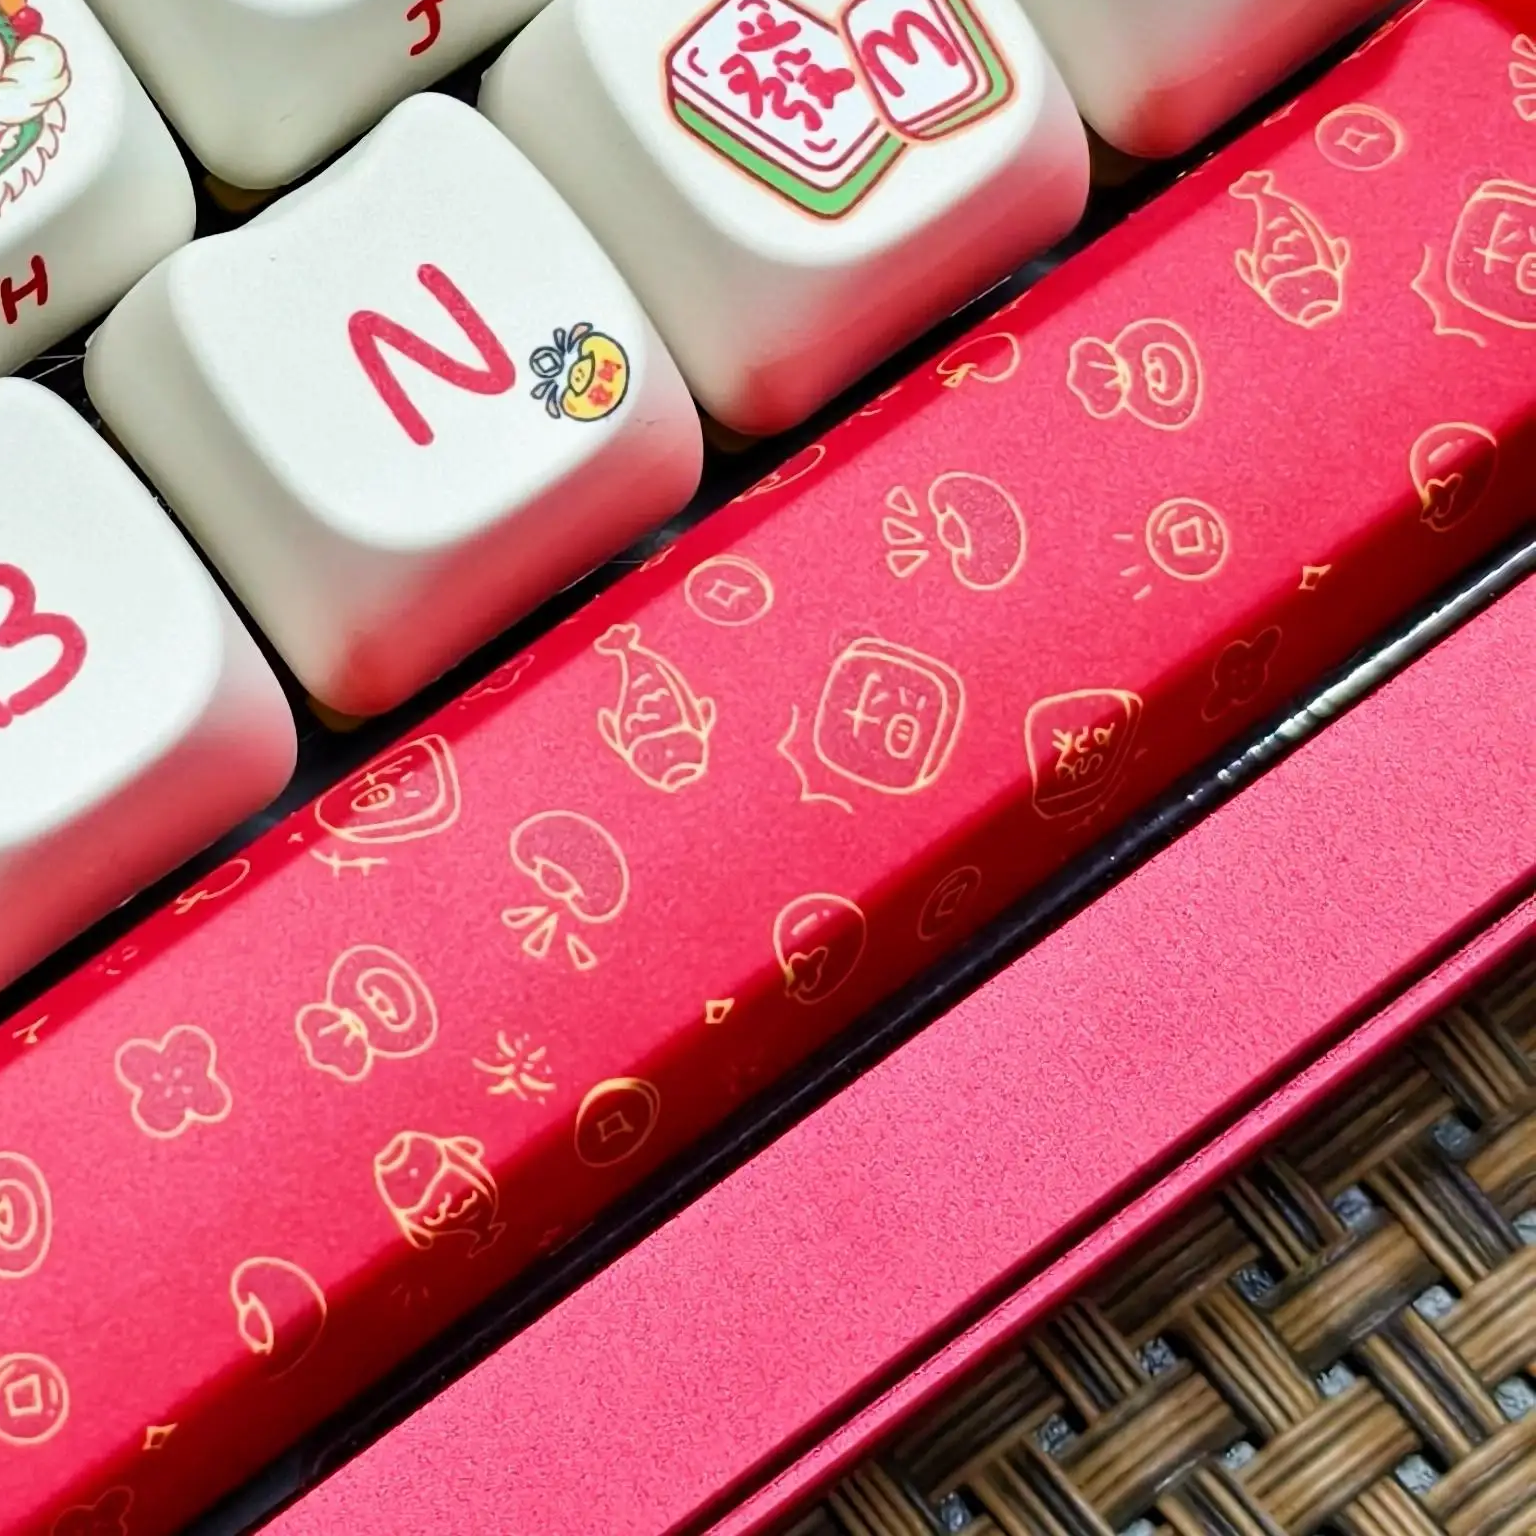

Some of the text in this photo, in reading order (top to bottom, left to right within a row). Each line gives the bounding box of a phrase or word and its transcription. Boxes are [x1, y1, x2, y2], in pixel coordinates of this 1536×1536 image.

[863, 10, 960, 98] M
[0, 255, 49, 323] H
[347, 263, 516, 447] N
